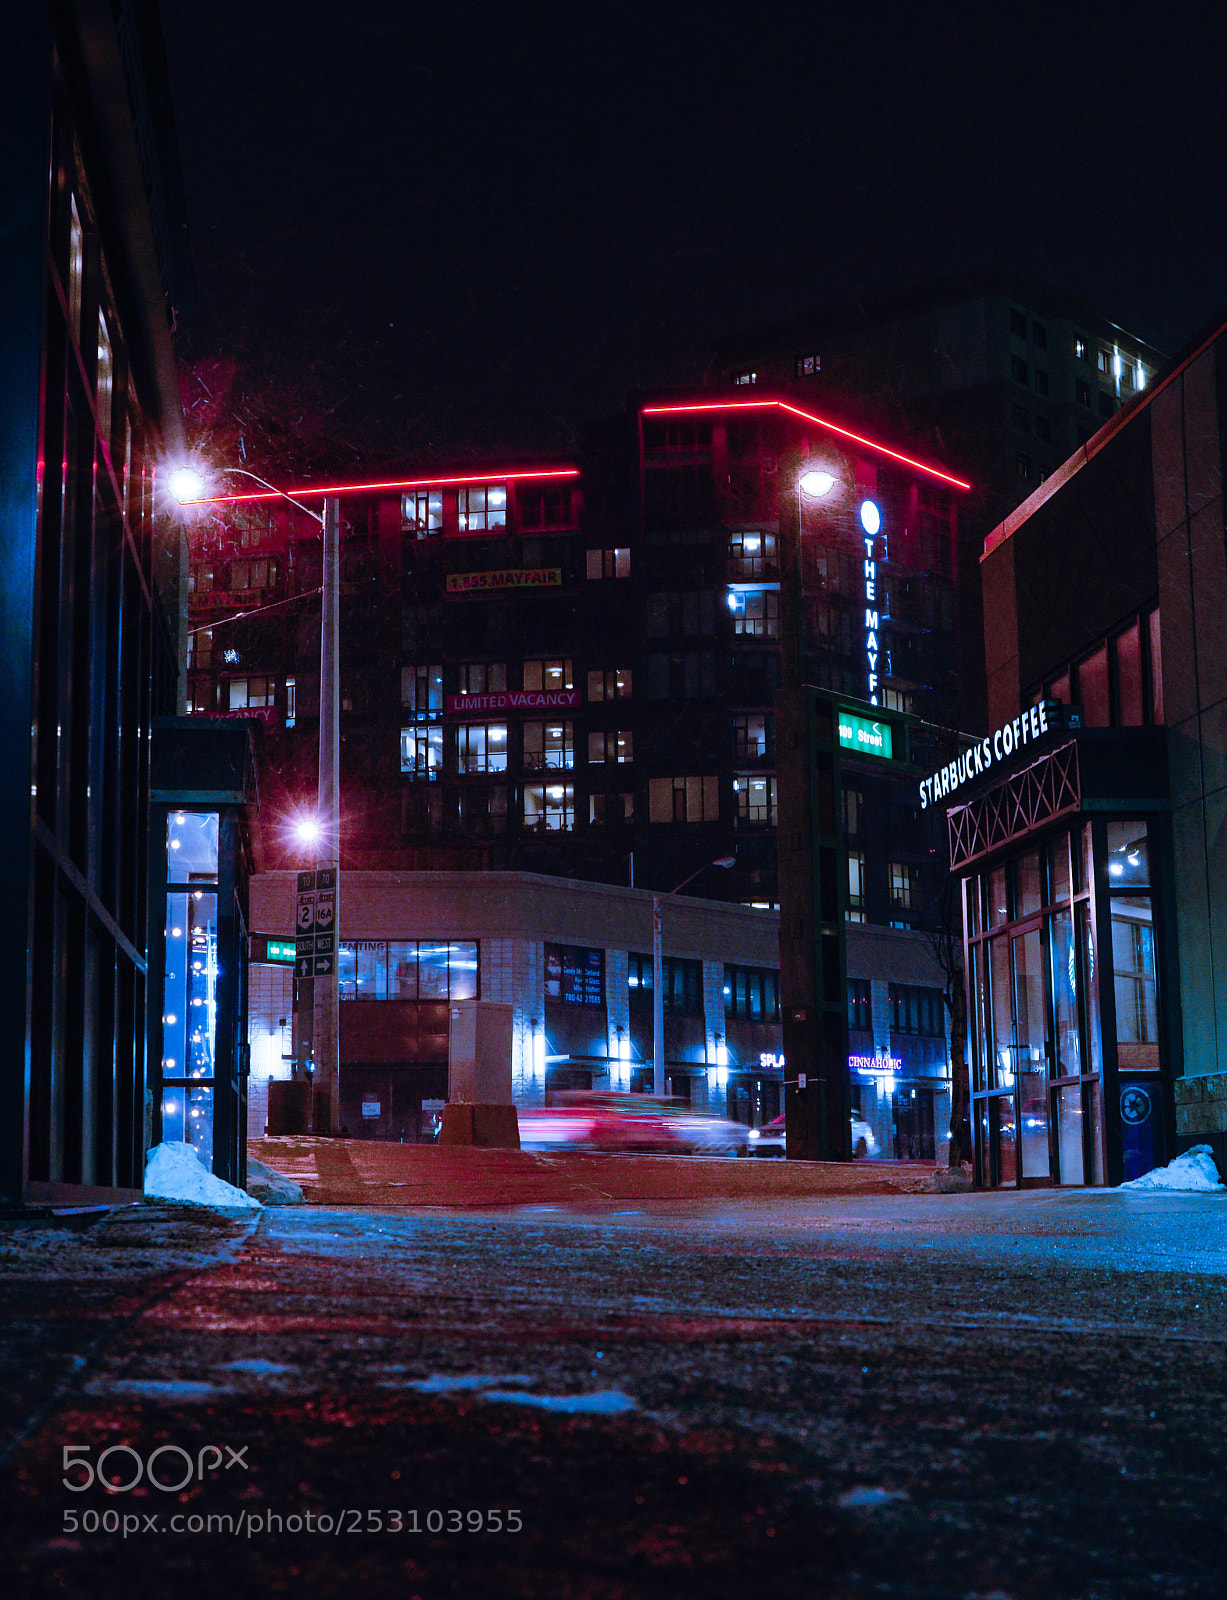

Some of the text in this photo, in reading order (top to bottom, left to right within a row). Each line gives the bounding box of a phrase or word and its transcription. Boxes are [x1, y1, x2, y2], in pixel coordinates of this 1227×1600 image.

[864, 538, 876, 601] THE
[454, 693, 576, 711] LIMITED VACANCY
[838, 724, 883, 747] 109 Street
[918, 699, 1049, 810] STARBUCKS COFFEE
[303, 876, 311, 887] TO
[322, 873, 330, 884] TO
[302, 906, 310, 922] 2
[317, 908, 332, 920] 16A
[317, 937, 332, 949] WEST
